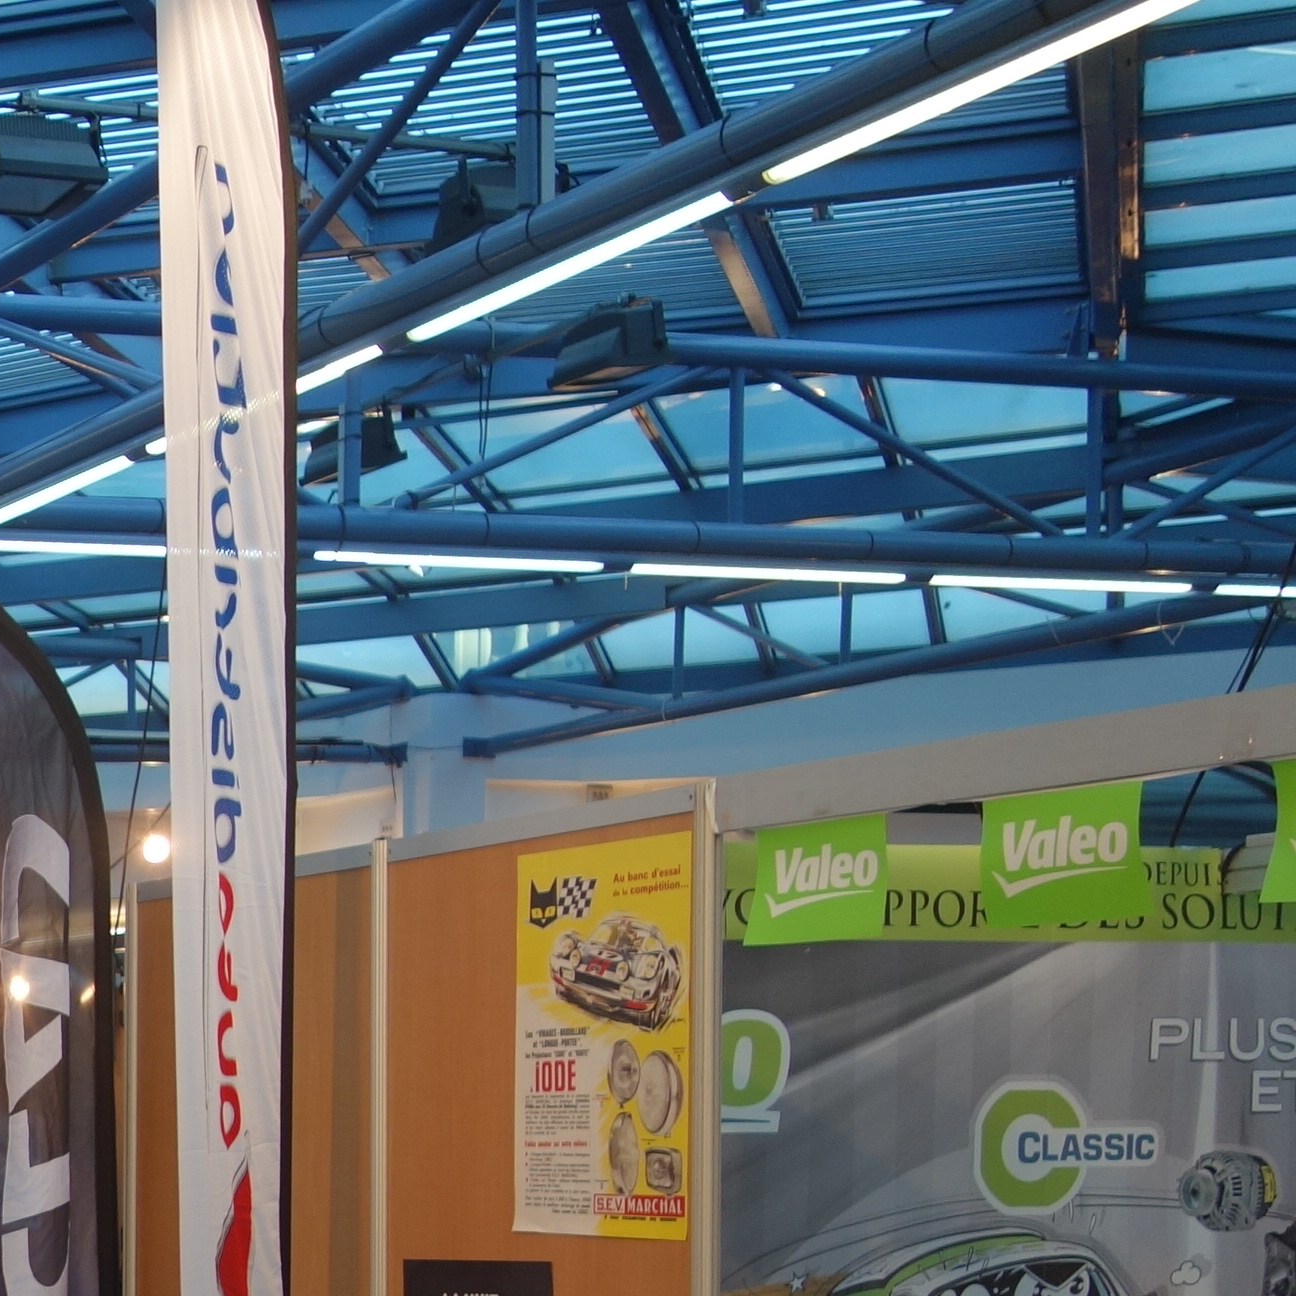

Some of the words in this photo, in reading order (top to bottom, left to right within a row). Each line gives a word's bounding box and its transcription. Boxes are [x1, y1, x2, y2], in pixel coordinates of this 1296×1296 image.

[1001, 814, 1129, 873] Valeo
[613, 872, 625, 884] Au
[627, 870, 649, 882] banc
[774, 842, 879, 896] Valeo
[1016, 1130, 1156, 1164] CLASSIC
[627, 1198, 683, 1215] MARCHAL
